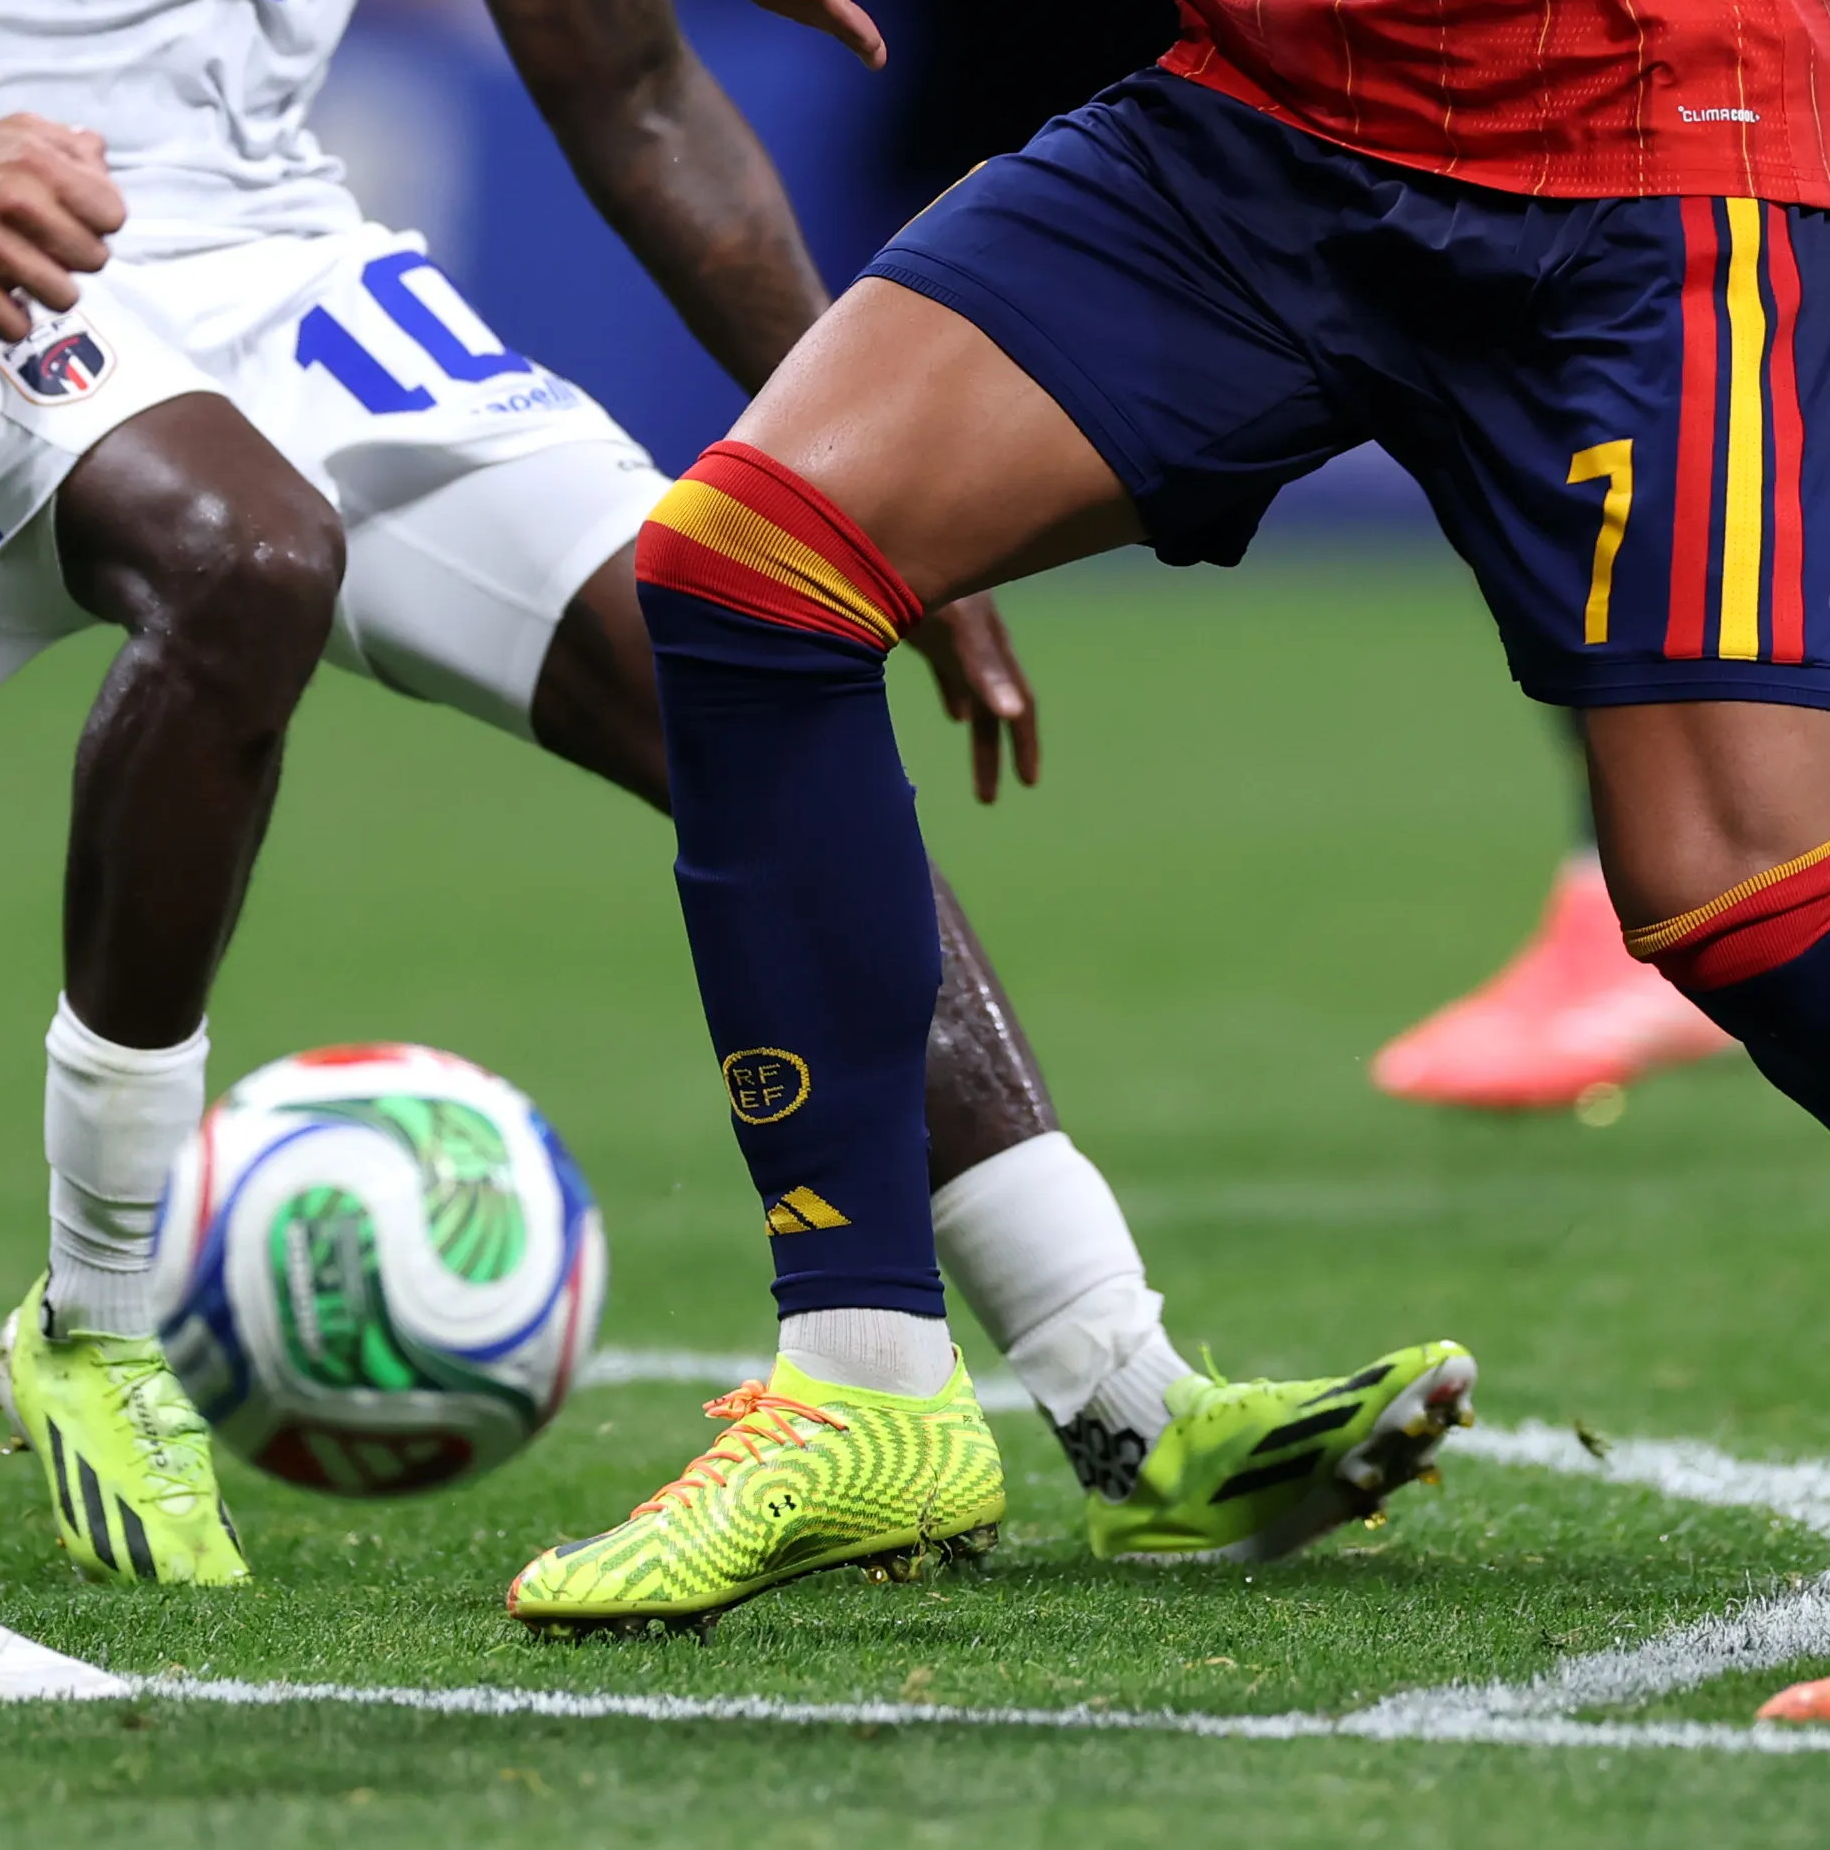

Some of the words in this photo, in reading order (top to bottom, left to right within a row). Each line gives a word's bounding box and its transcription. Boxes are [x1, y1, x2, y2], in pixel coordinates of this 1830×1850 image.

[295, 250, 536, 415] 10
[1566, 438, 1634, 645] 7
[732, 1063, 781, 1087] RF
[739, 1084, 786, 1109] EF
